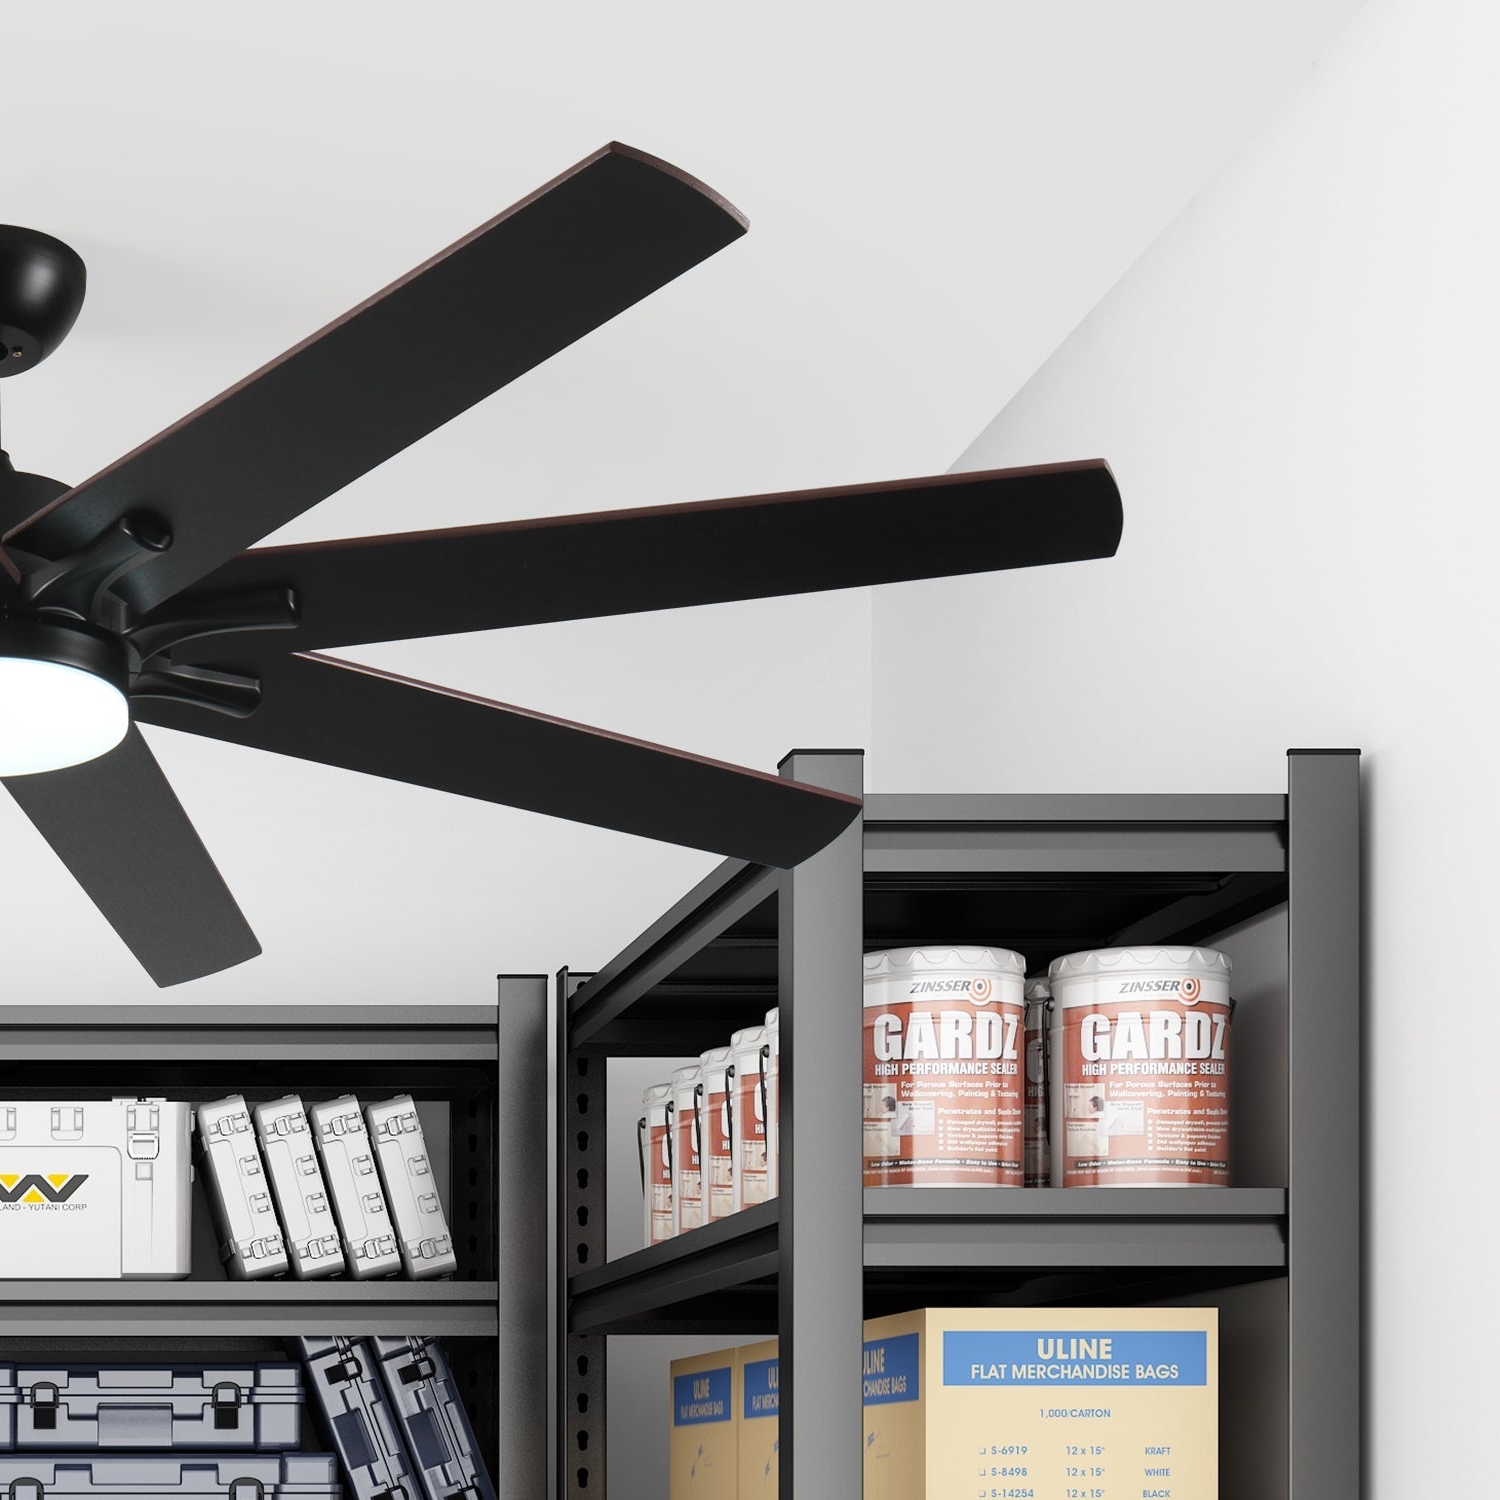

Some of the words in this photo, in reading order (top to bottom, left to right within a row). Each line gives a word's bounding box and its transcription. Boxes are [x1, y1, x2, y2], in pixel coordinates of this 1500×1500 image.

[910, 980, 972, 994] ZINSSER
[1119, 980, 1181, 994] ZINSSER
[873, 1010, 1019, 1062] GARDZ
[1080, 1010, 1227, 1062] GARDZ
[875, 1063, 899, 1076] HIGH
[902, 1062, 989, 1076] PERFORMANCE
[991, 1063, 1018, 1076] SEALER
[1082, 1063, 1107, 1076] HIGH
[1110, 1062, 1197, 1076] PERFORMANCE
[1199, 1063, 1226, 1076] SEALER
[27, 1203, 60, 1212] YUTANI
[61, 1203, 87, 1212] CORP
[1037, 1338, 1112, 1360] ULINE
[971, 1364, 1008, 1380] FLAT
[1011, 1364, 1130, 1380] MERCHANDISE
[1135, 1364, 1179, 1380] BAGS
[693, 1378, 710, 1400] ULINE
[990, 1445, 1028, 1456] S-6919
[1066, 1445, 1078, 1456] 12
[1144, 1446, 1171, 1456] KRAFT
[990, 1467, 1028, 1477] S-8498
[1066, 1467, 1078, 1477] 12
[1144, 1467, 1171, 1477] WHITE
[990, 1488, 1034, 1499] S-14254
[1066, 1488, 1078, 1499] 12
[1142, 1489, 1171, 1499] BLACK
